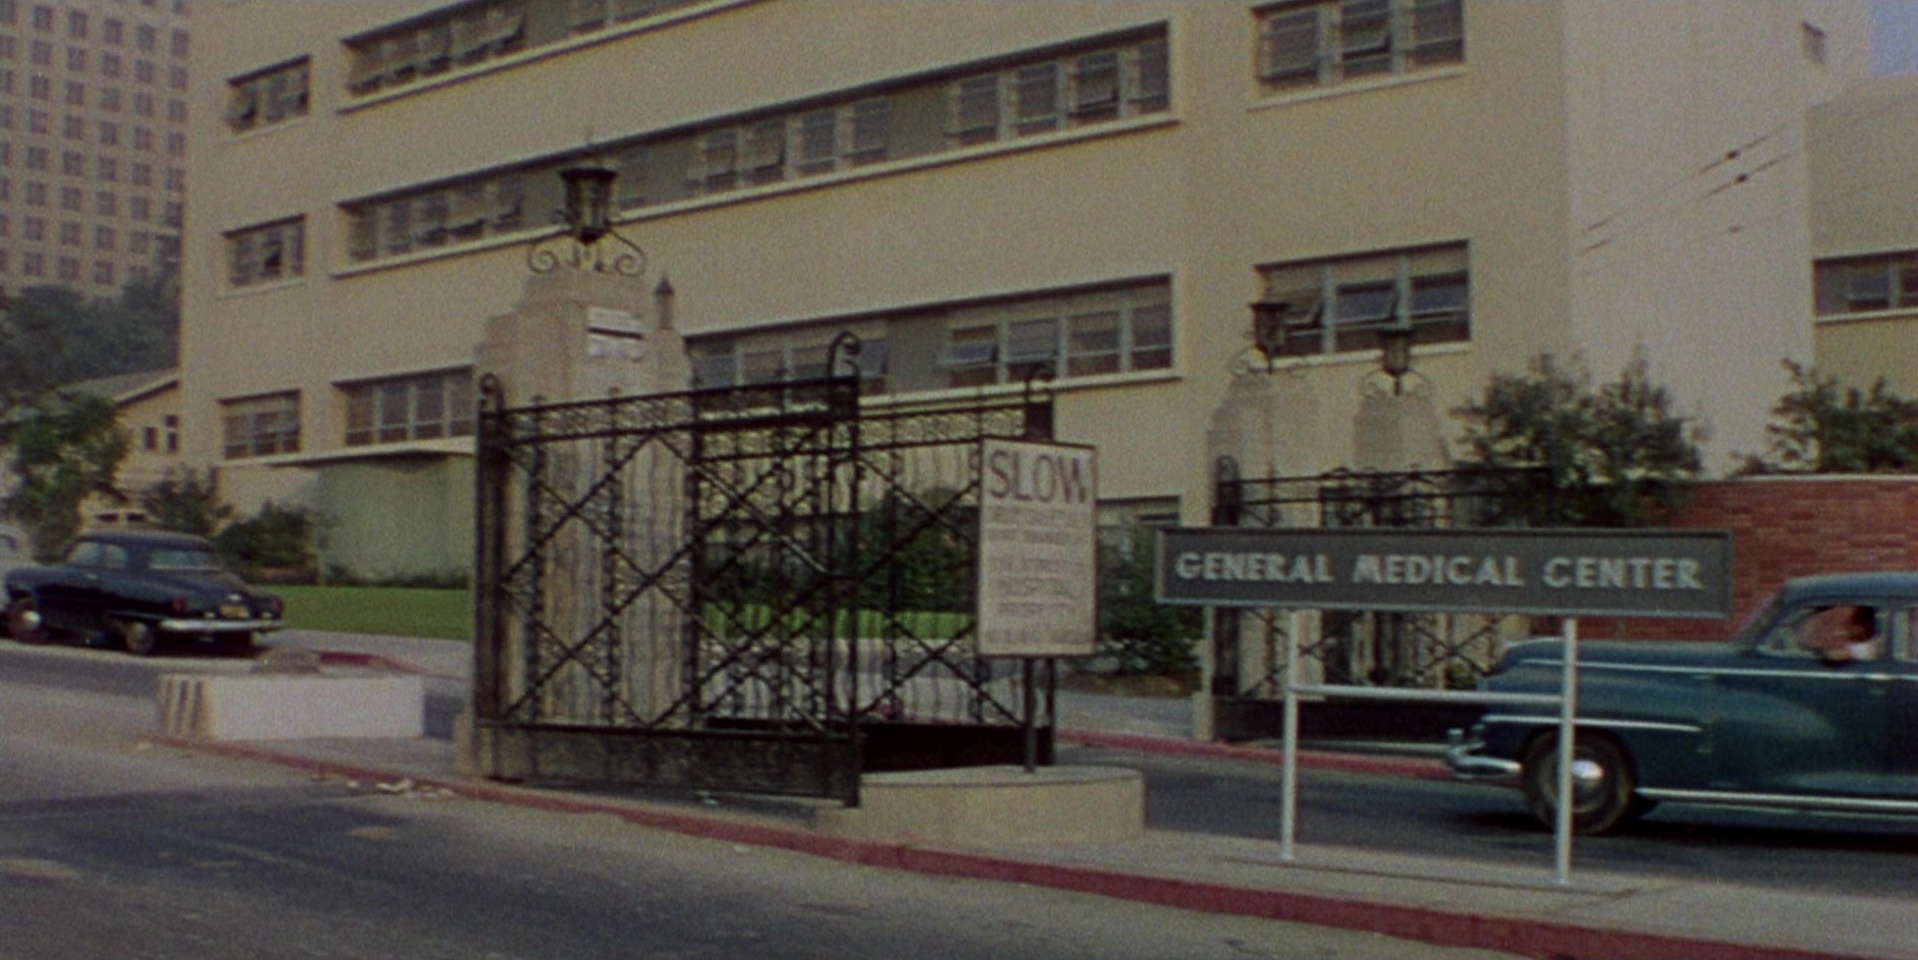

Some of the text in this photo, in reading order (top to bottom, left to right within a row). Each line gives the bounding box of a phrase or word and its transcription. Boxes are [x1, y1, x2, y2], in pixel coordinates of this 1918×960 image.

[988, 450, 1087, 503] SLOW
[1176, 552, 1704, 589] GENERAL MEDICAL CENTER
